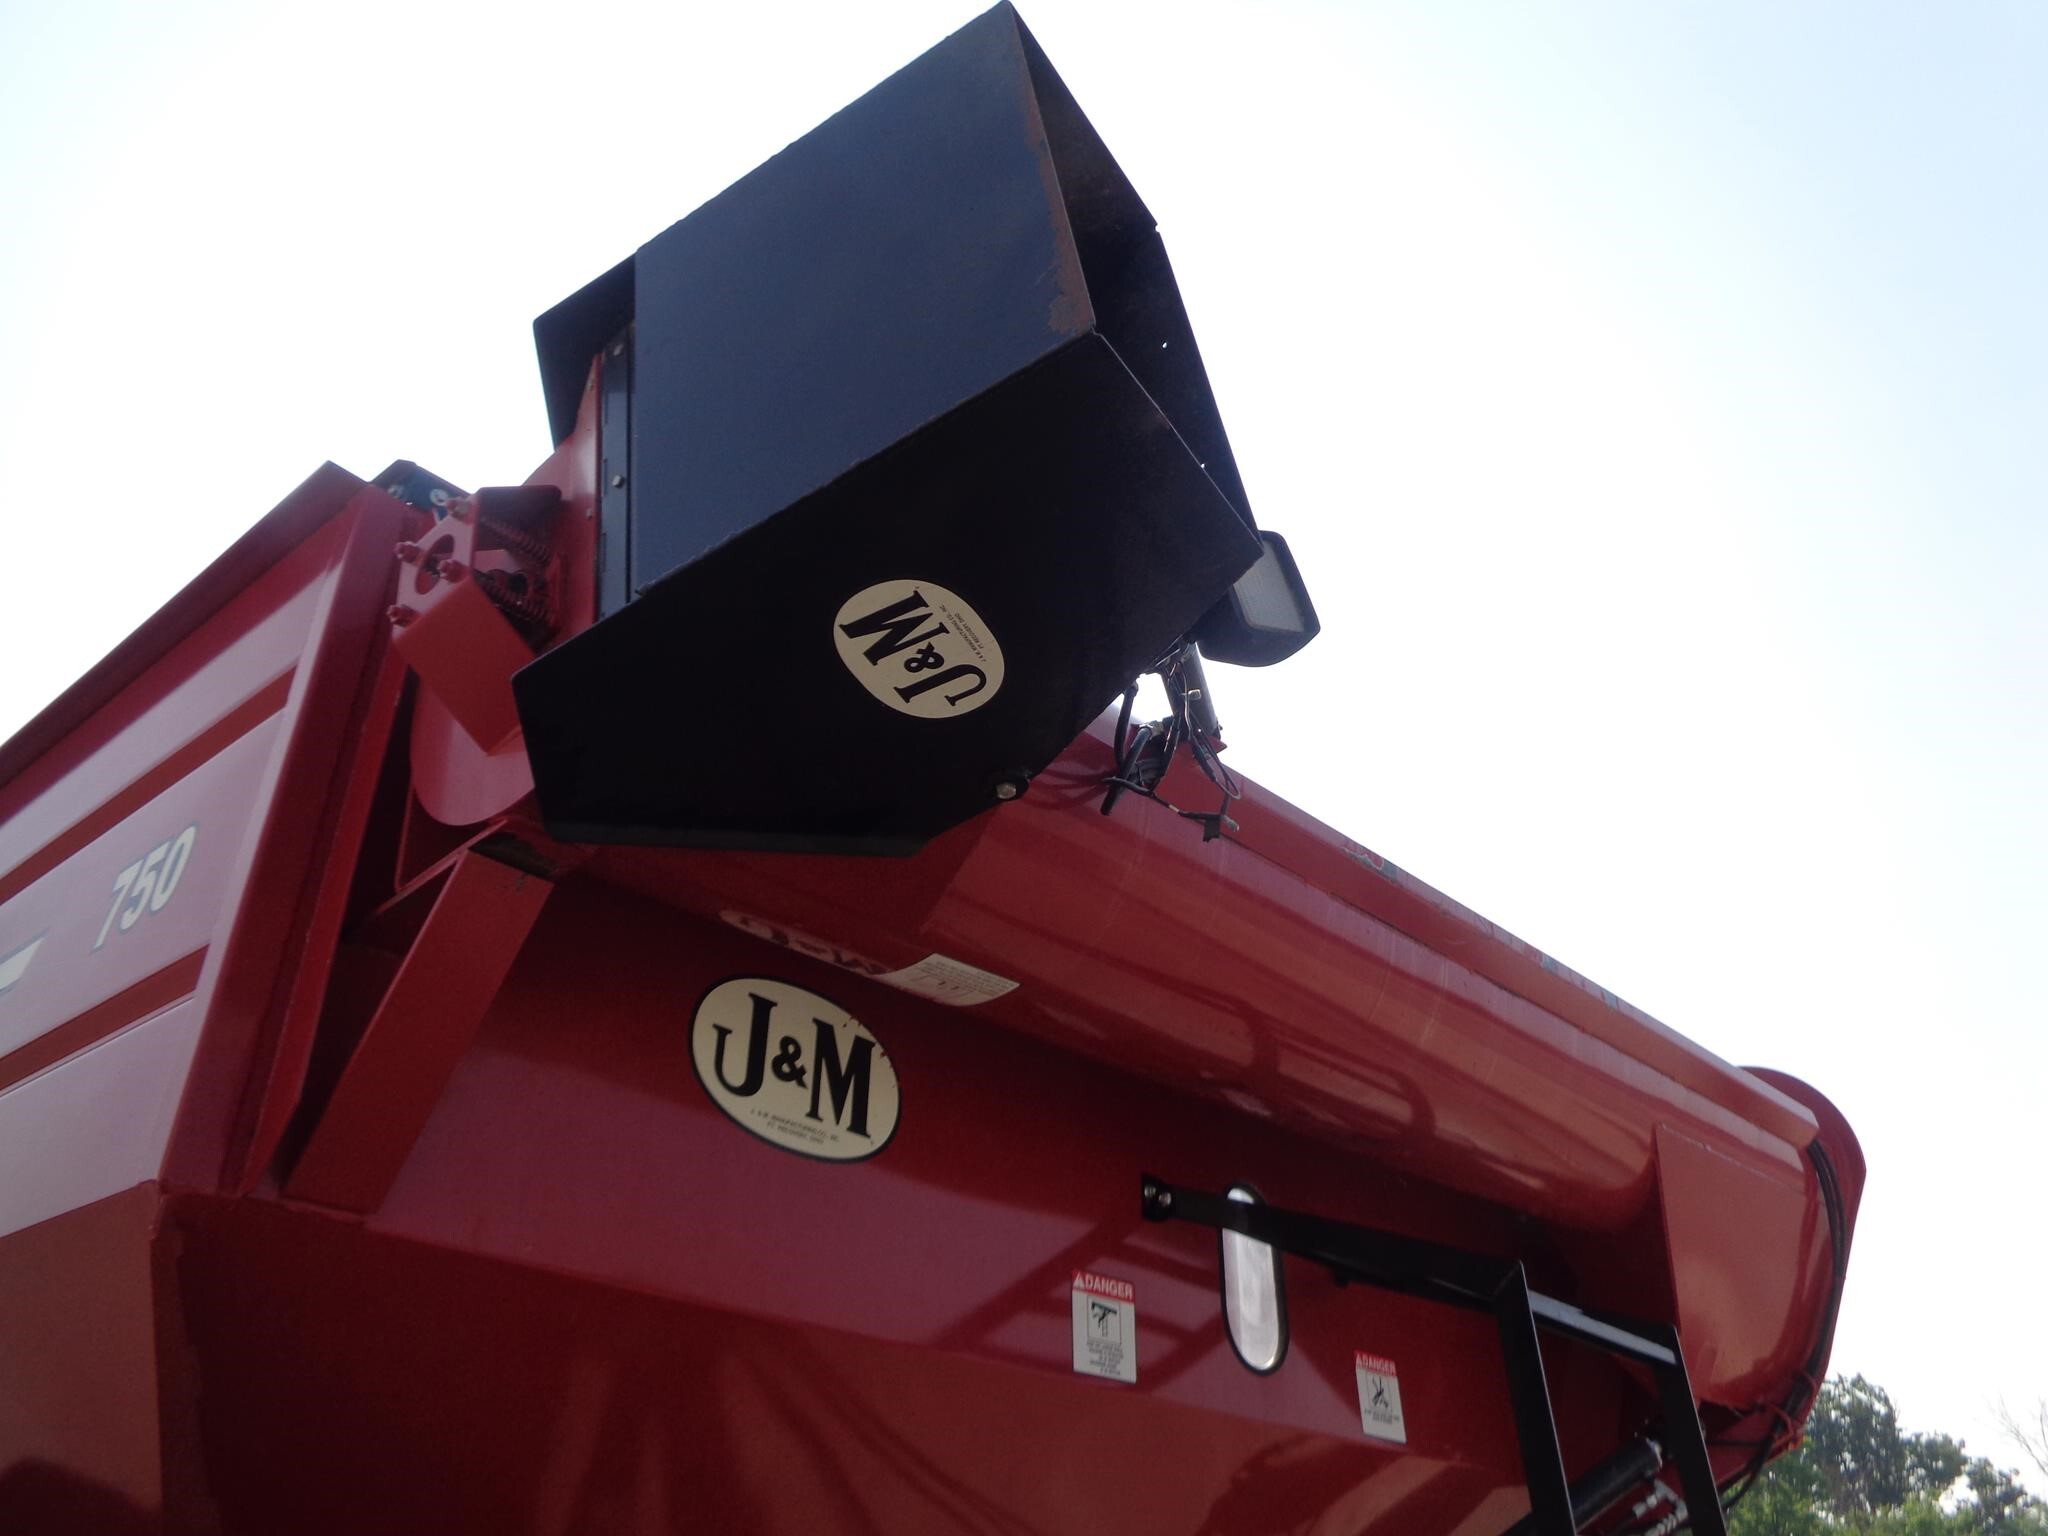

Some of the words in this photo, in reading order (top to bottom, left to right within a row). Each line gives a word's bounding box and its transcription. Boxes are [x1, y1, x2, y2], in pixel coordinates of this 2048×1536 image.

[838, 590, 987, 706] J&M
[92, 822, 198, 951] 750
[712, 992, 877, 1138] J&M
[1085, 1273, 1133, 1300] DANGER
[1363, 1353, 1397, 1377] DANGER
